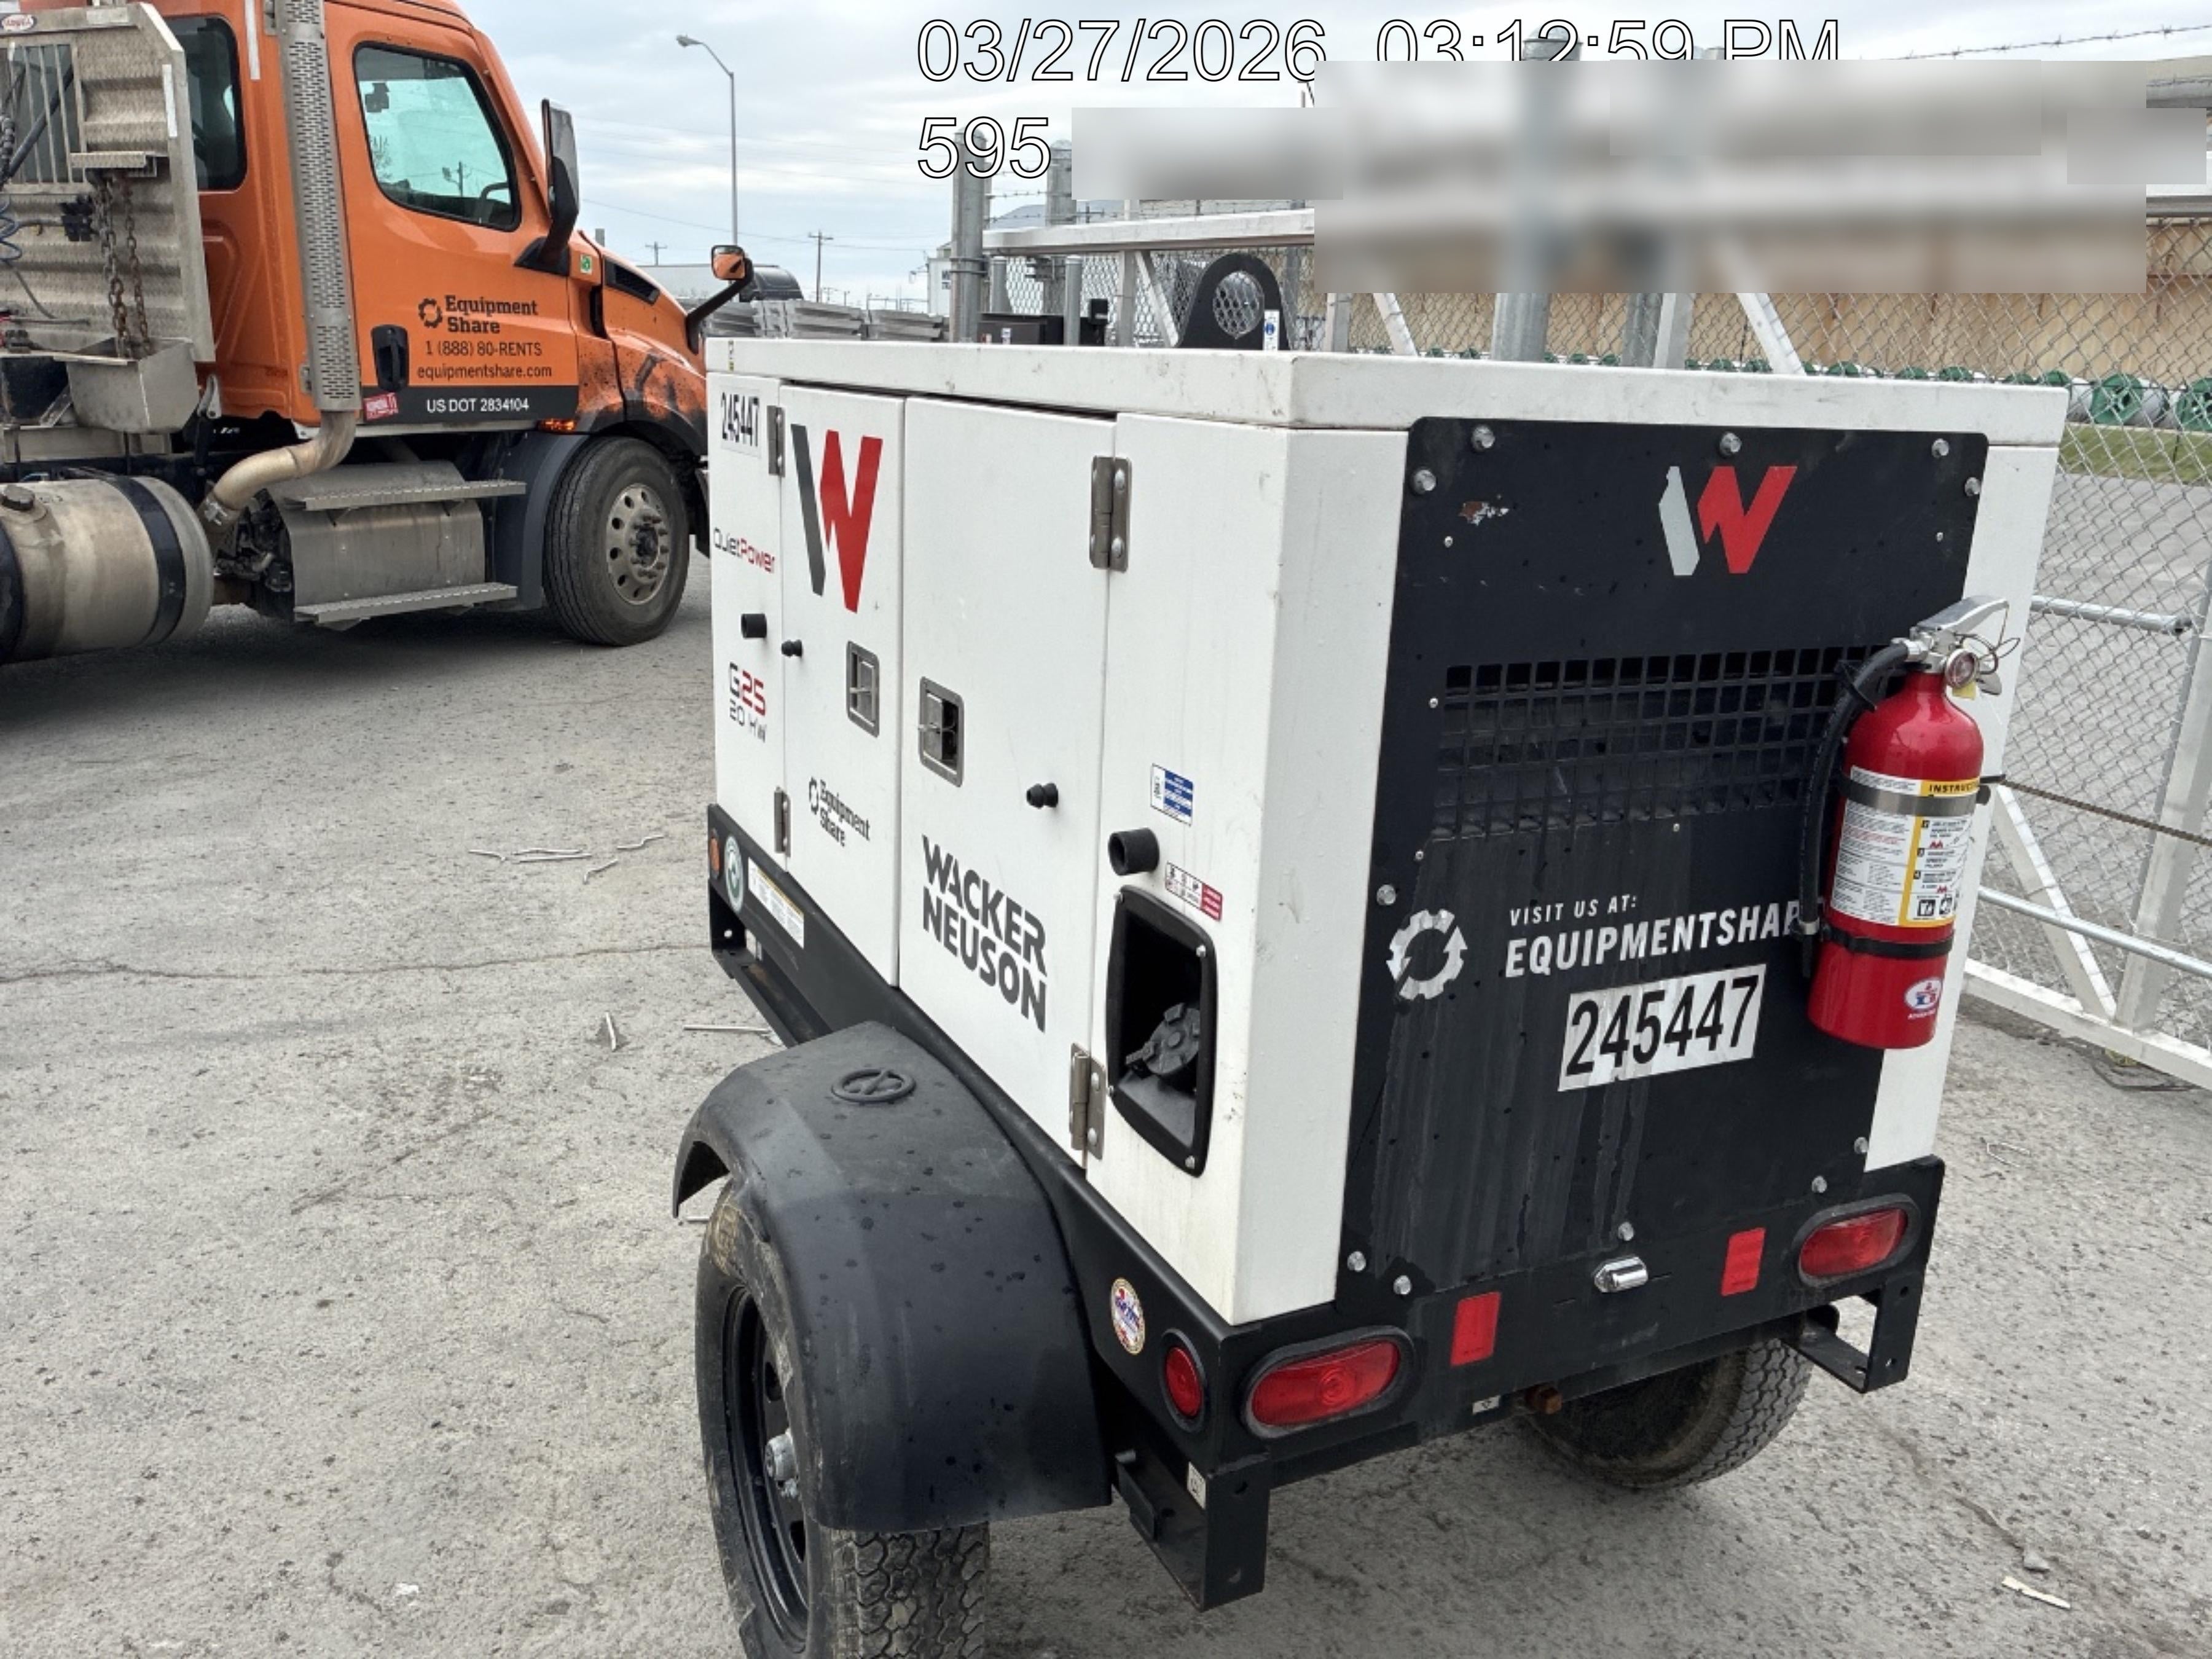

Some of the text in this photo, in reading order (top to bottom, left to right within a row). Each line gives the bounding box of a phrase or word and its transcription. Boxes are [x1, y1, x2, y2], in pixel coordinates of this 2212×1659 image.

[445, 294, 538, 316] Equipment
[447, 316, 501, 334] Share
[426, 340, 543, 356] 1 (888) 80-RENTS
[417, 363, 552, 382] equipmentshare.com
[426, 398, 530, 413] US DOT 2834104
[820, 779, 870, 841] Equipment
[820, 807, 845, 848] Share
[921, 834, 1048, 977] WACKER
[1510, 895, 1637, 927] VISIT US AT:
[922, 885, 1047, 1033] NEUSON
[1566, 975, 1759, 1076] 245447
